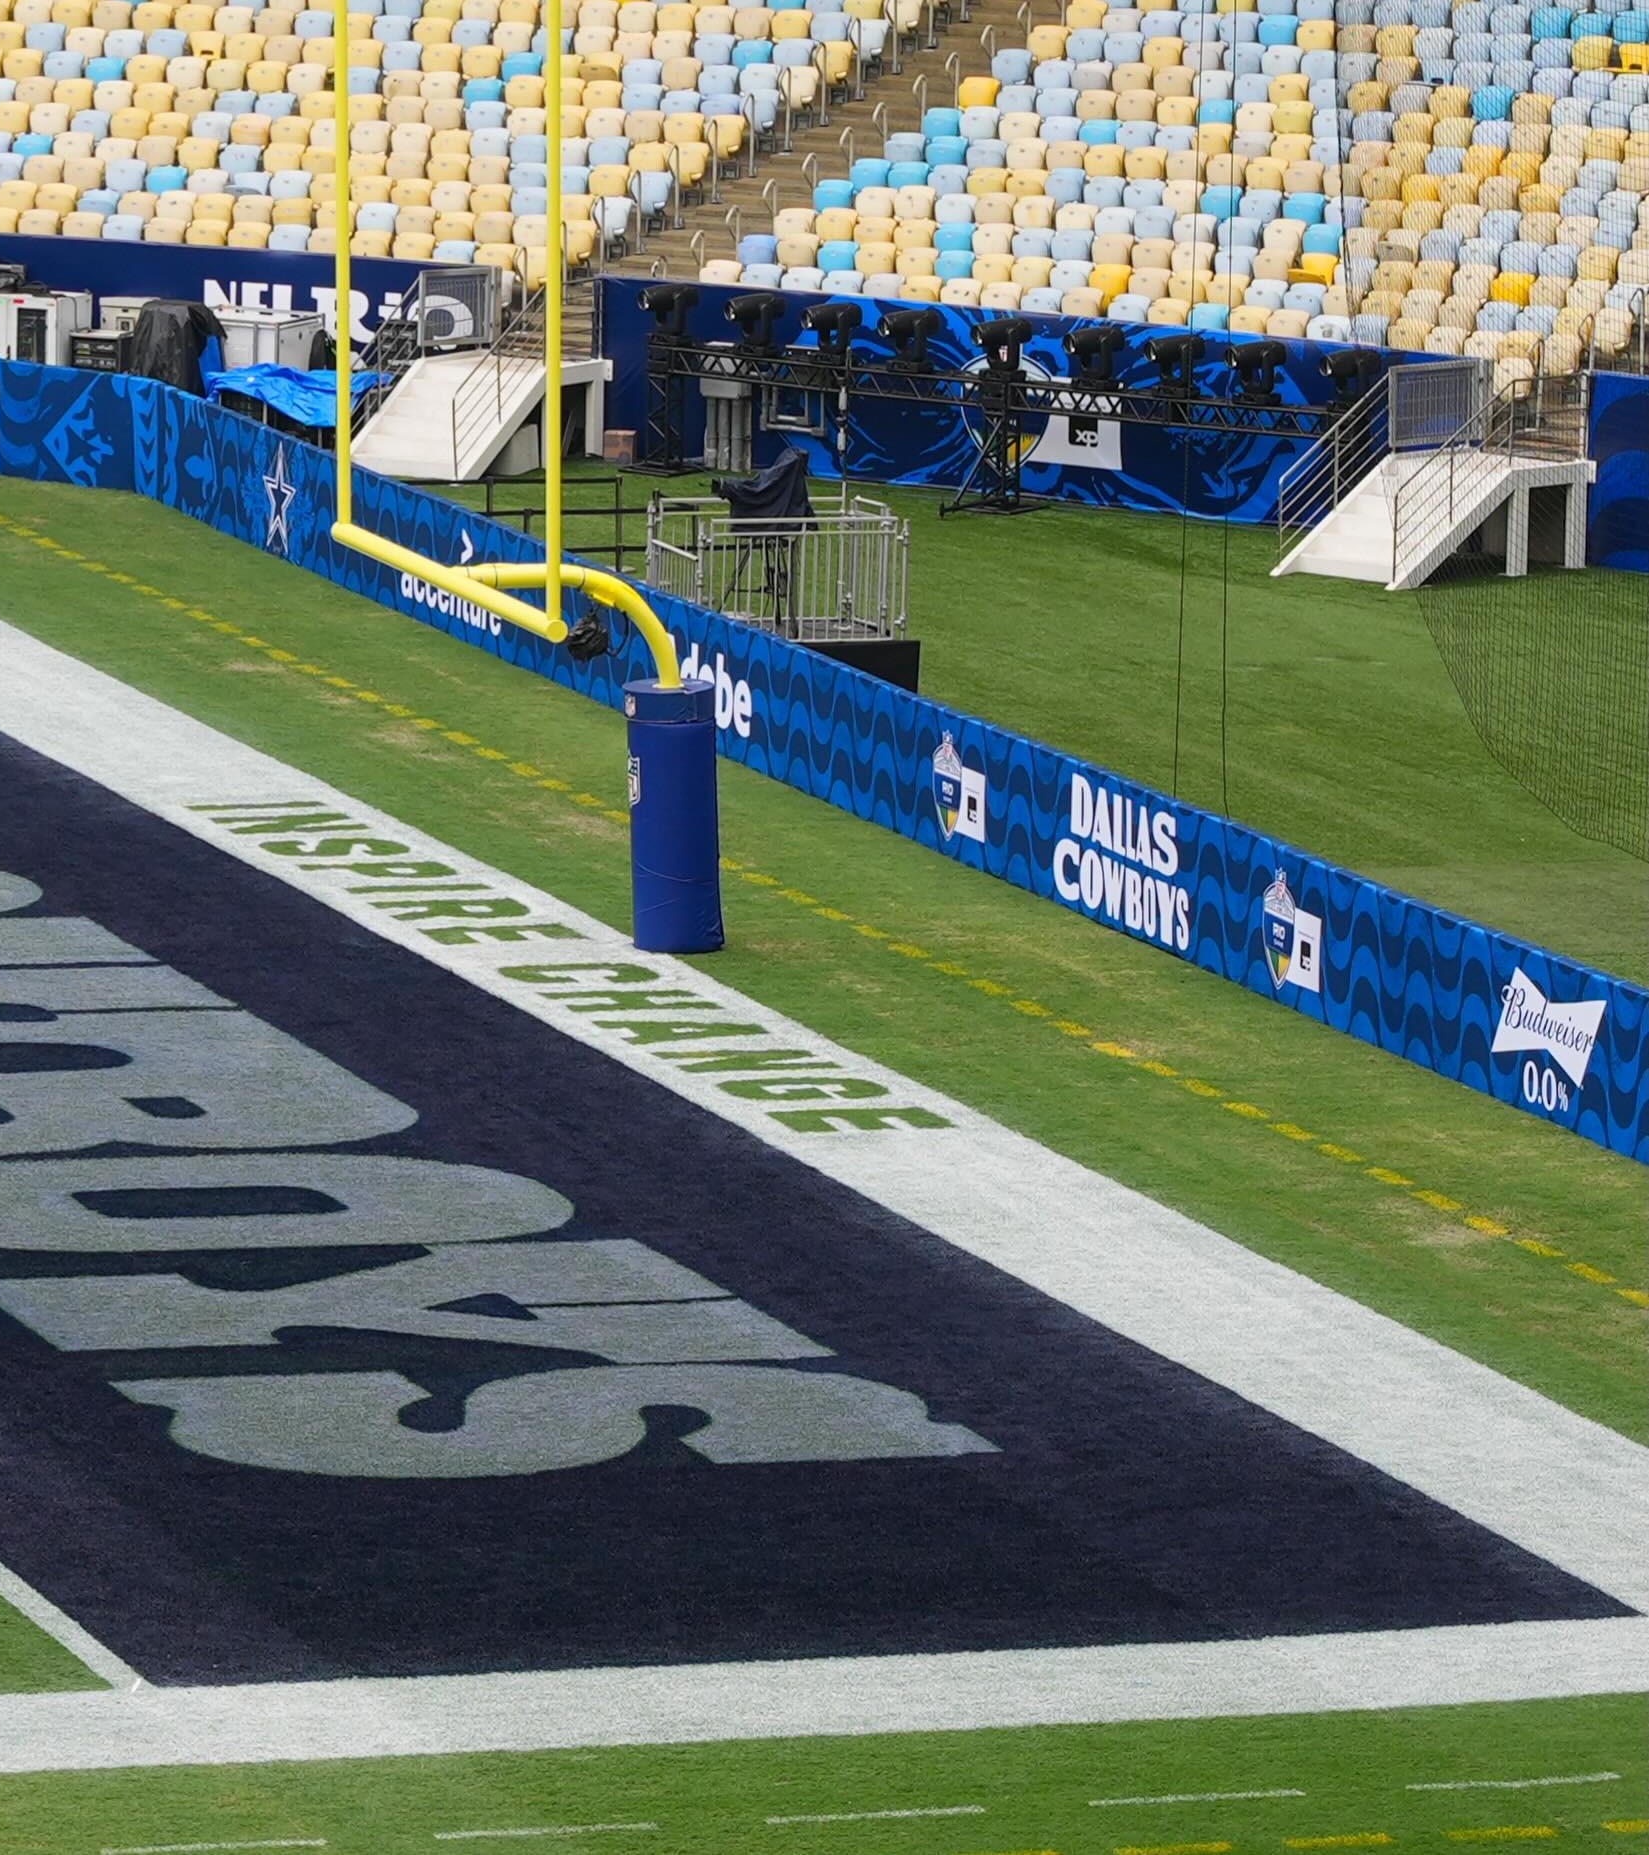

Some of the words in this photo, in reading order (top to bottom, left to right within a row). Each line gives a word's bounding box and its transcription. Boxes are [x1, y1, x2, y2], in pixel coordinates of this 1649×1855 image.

[1075, 429, 1099, 448] xp
[667, 633, 752, 738] dbe
[1070, 773, 1179, 877] DALLAS
[1053, 838, 1190, 951] COWBOYS
[185, 800, 590, 945] INSPIRE
[499, 961, 955, 1134] CHANGE
[1501, 985, 1593, 1054] Budweiser
[1523, 1060, 1569, 1112] 0.0%
